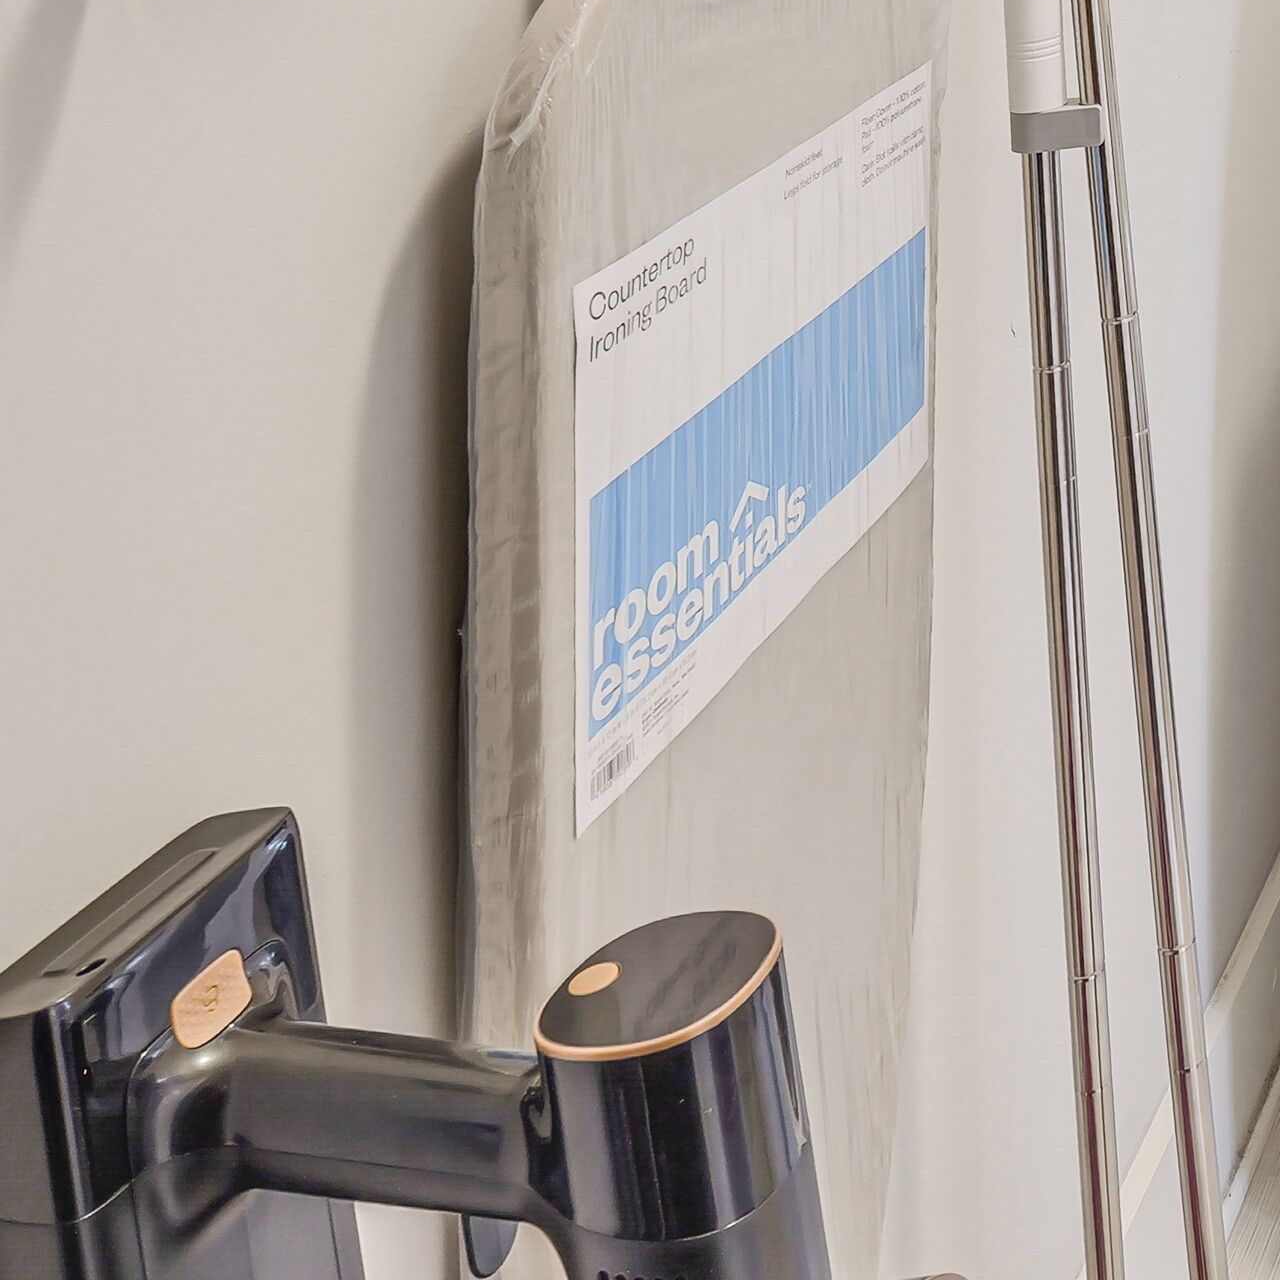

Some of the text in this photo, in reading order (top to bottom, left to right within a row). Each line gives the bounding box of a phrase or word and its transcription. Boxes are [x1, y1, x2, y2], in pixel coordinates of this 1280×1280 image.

[589, 238, 694, 320] Countertop
[590, 256, 707, 362] Ironing Board
[592, 483, 807, 721] essentials
[594, 520, 719, 670] room
